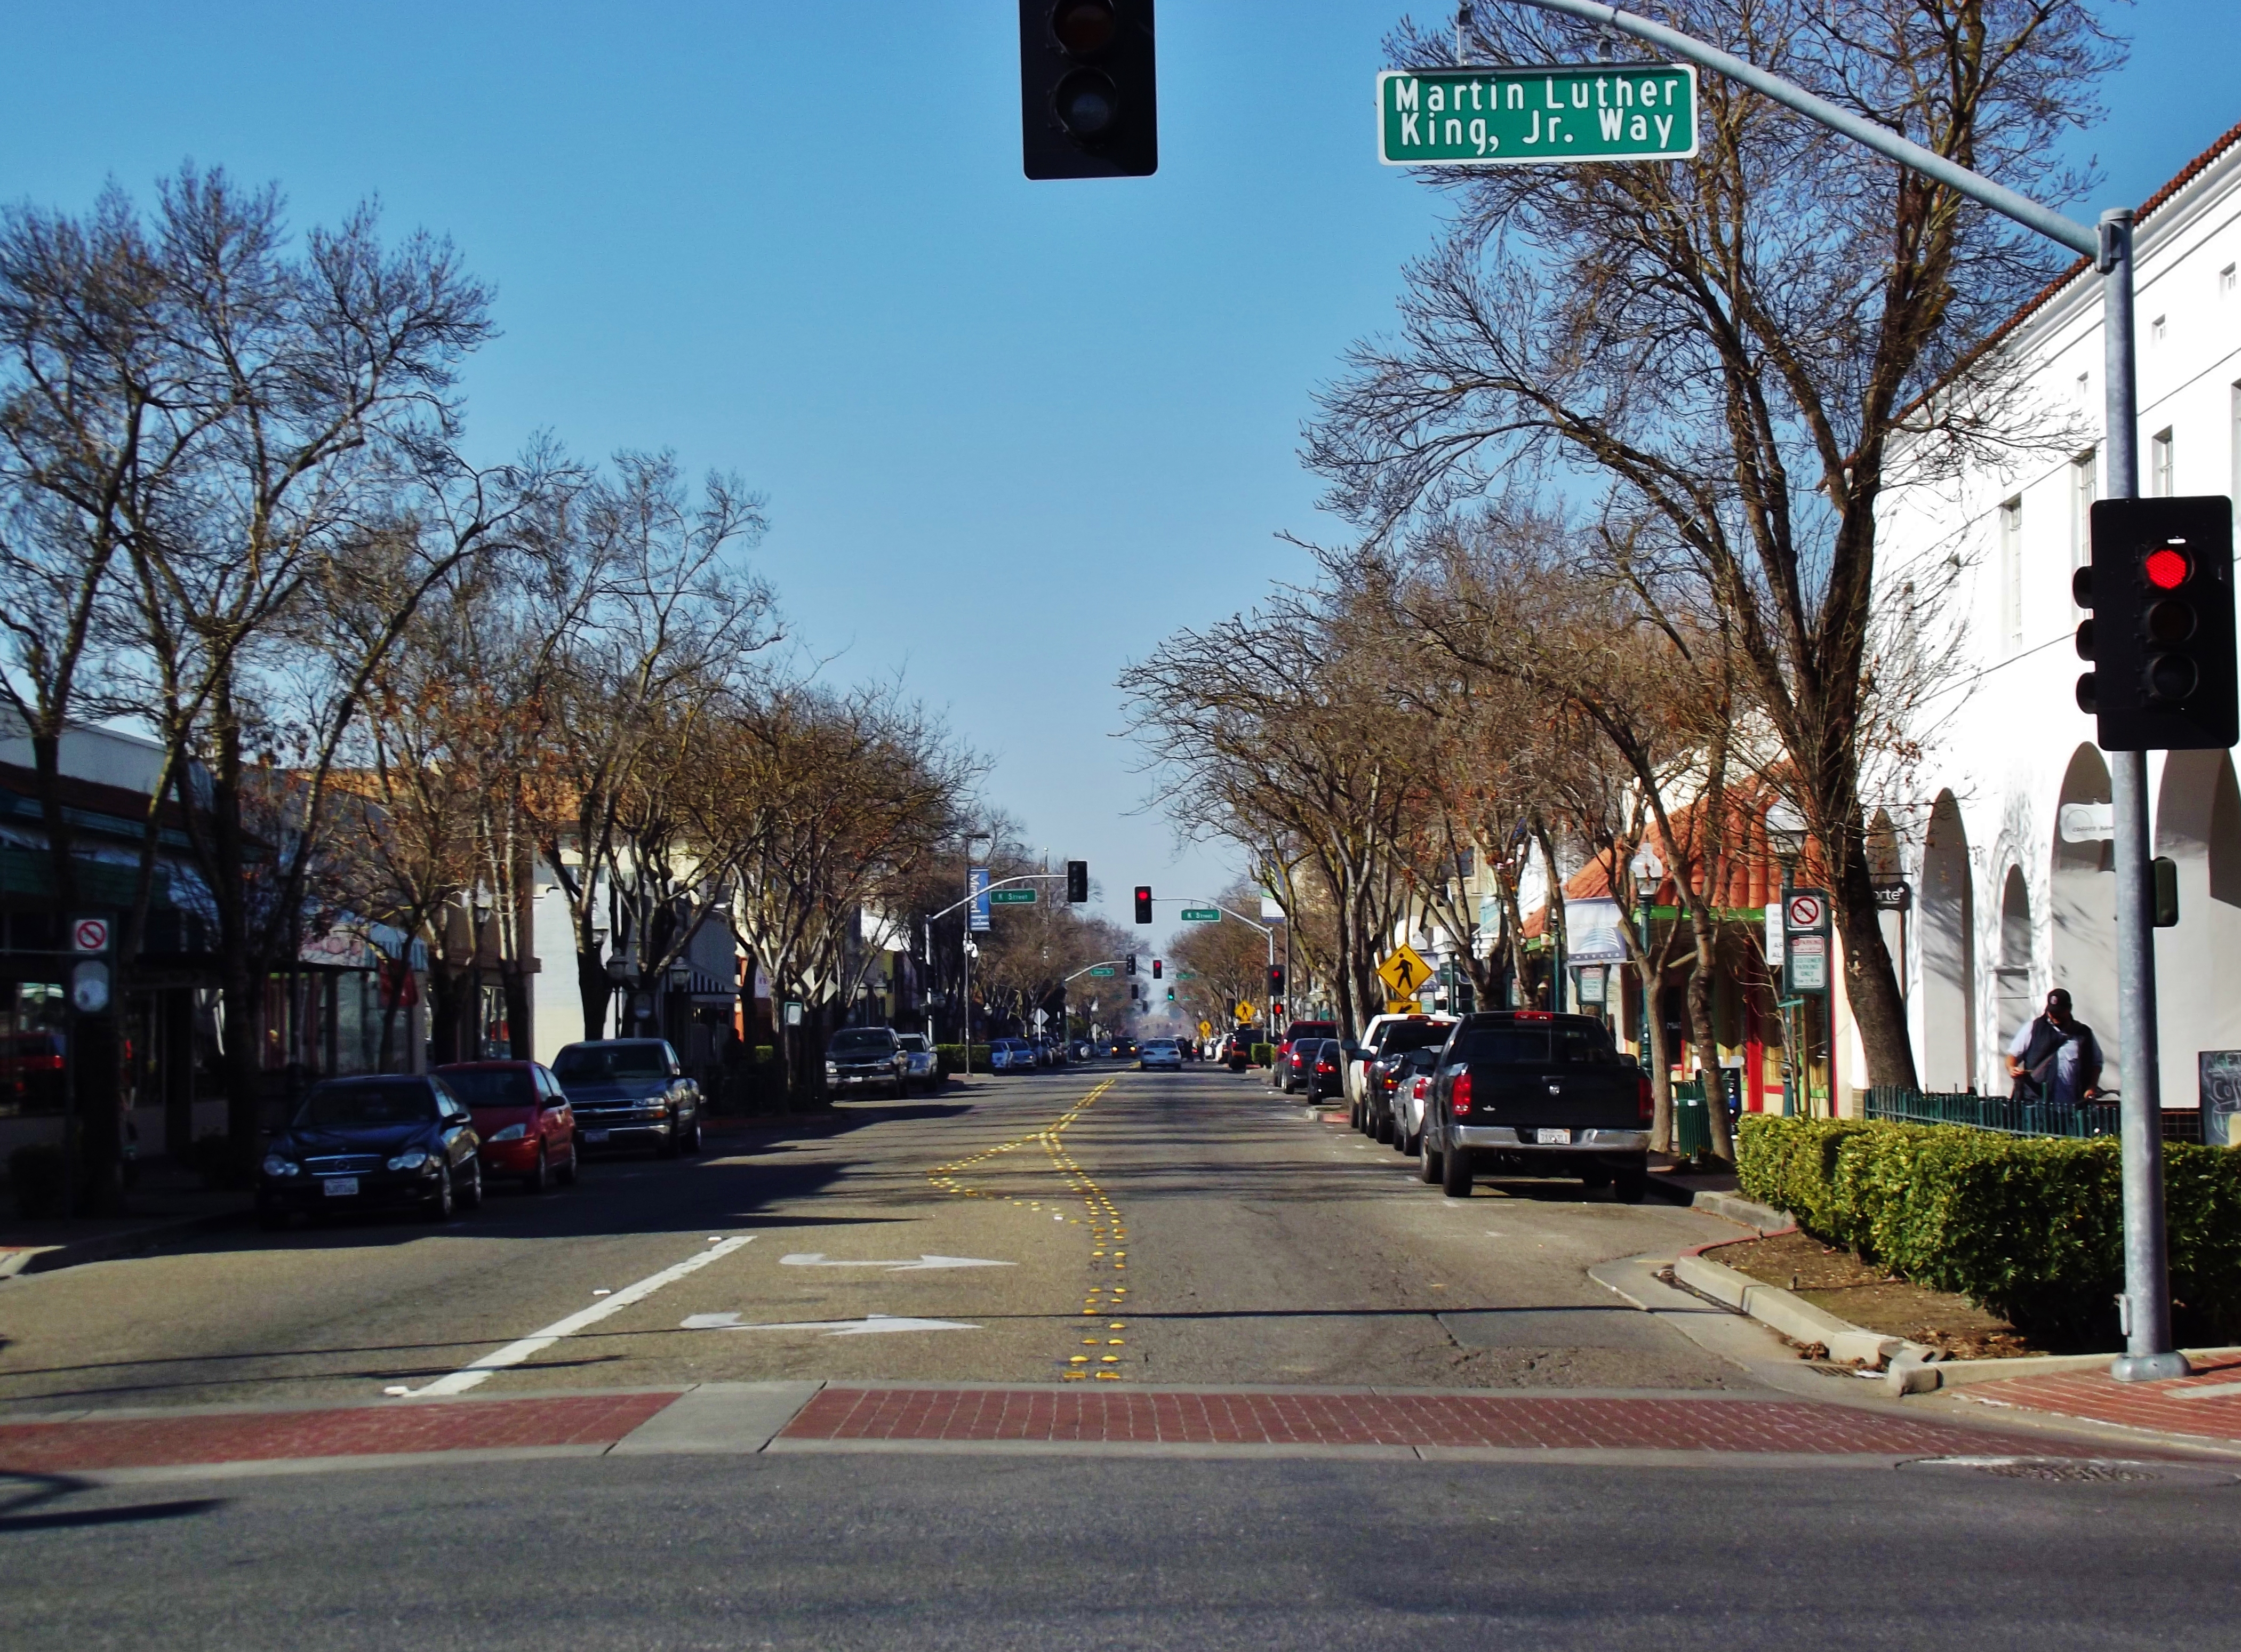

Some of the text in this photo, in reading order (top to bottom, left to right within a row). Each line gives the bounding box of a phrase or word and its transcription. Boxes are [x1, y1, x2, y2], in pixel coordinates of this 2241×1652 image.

[1394, 75, 1678, 113] Martin Luther
[1401, 107, 1674, 156] King, Jr. Way
